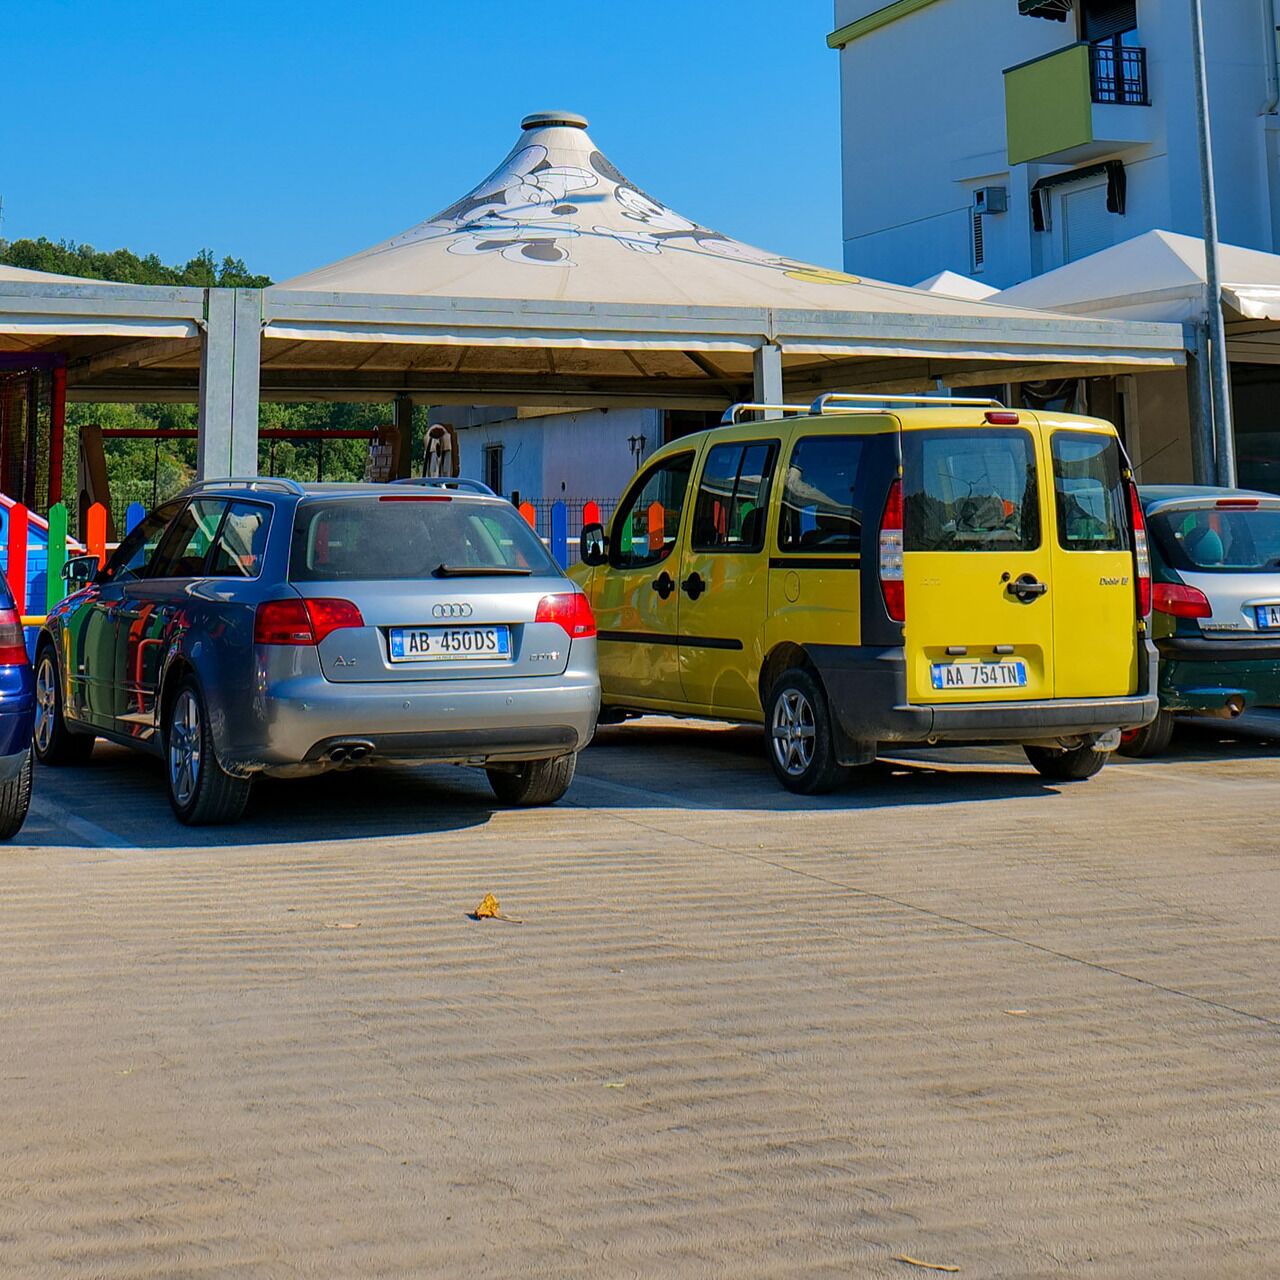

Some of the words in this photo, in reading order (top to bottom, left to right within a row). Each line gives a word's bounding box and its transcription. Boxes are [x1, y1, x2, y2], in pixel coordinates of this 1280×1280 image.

[409, 632, 430, 653] AB
[441, 630, 496, 651] 450DS
[946, 667, 964, 686] AA
[971, 665, 1017, 685] 754TN
